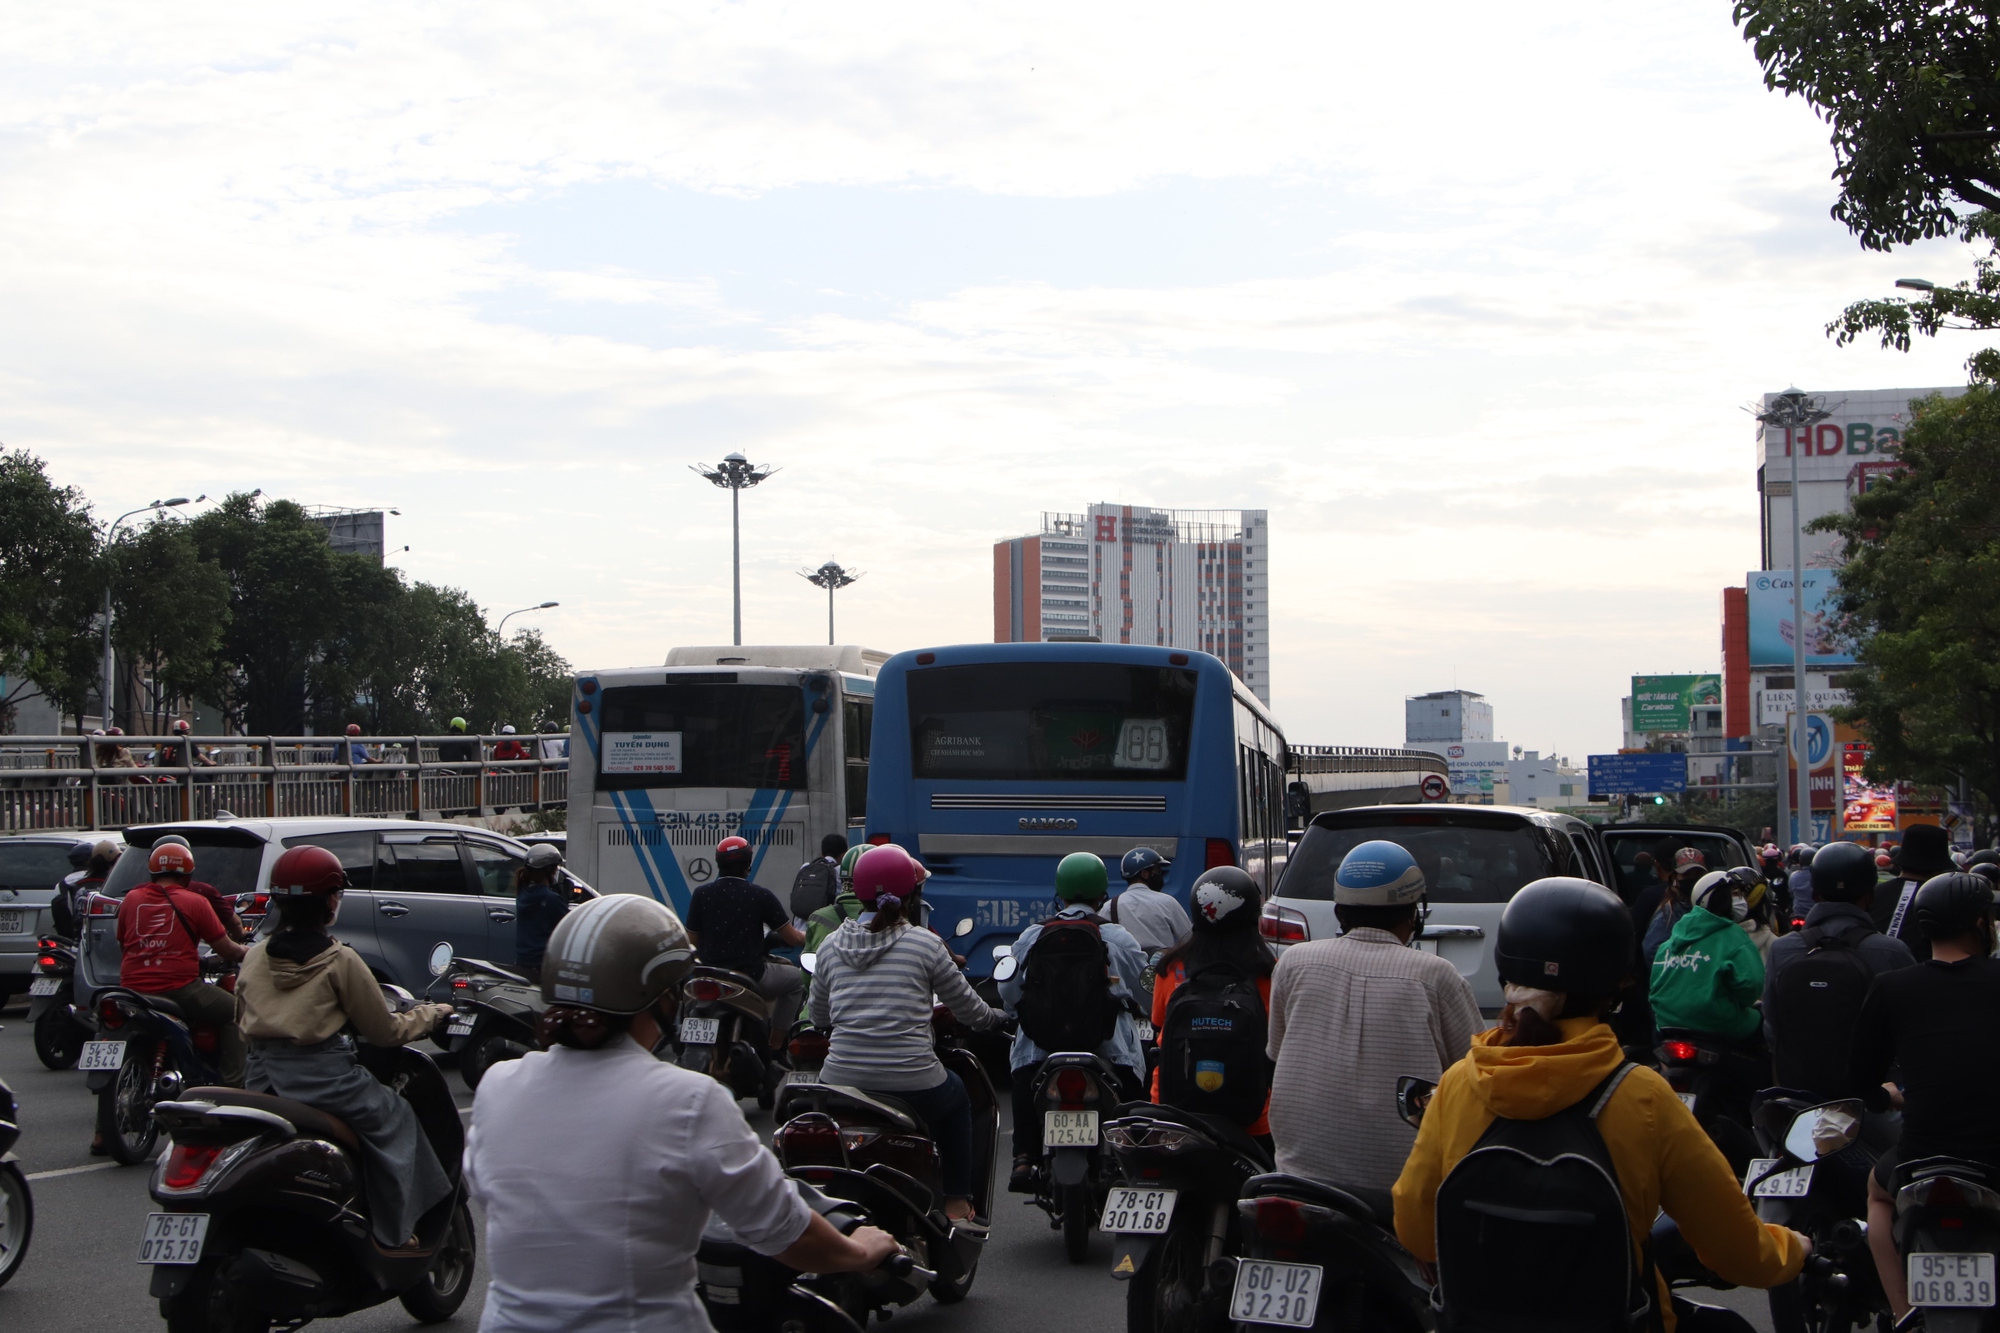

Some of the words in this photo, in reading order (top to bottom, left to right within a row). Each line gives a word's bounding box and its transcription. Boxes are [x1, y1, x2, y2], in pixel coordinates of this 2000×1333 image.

[1785, 422, 1903, 457] HDBa
[1095, 515, 1117, 542] H
[1771, 578, 1816, 589] Caser
[1641, 703, 1675, 711] Carabao
[615, 740, 643, 748] TUYỂN
[935, 736, 982, 745] AGRIBANK
[1810, 776, 1834, 790] INH
[1018, 817, 1078, 831] SAMCO
[140, 938, 168, 948] Now
[687, 1019, 713, 1031] 59-U1
[1191, 1017, 1232, 1027] HUTECH
[683, 1030, 715, 1042] 215.92
[89, 1043, 120, 1055] 54-S6
[86, 1055, 117, 1068] 9544
[1053, 1113, 1090, 1128] 60-AA
[1049, 1129, 1095, 1144] 125.44
[1757, 1179, 1807, 1194] 49.15
[1116, 1190, 1165, 1211] 78-G1
[154, 1216, 199, 1237] 76-G1
[1105, 1210, 1167, 1231] 301.68
[142, 1239, 200, 1260] 075.79
[1922, 1256, 1979, 1278] 95-E1
[1247, 1263, 1312, 1294] 60-U2
[1913, 1280, 1991, 1302] 068.39
[1241, 1291, 1308, 1322] 3230
